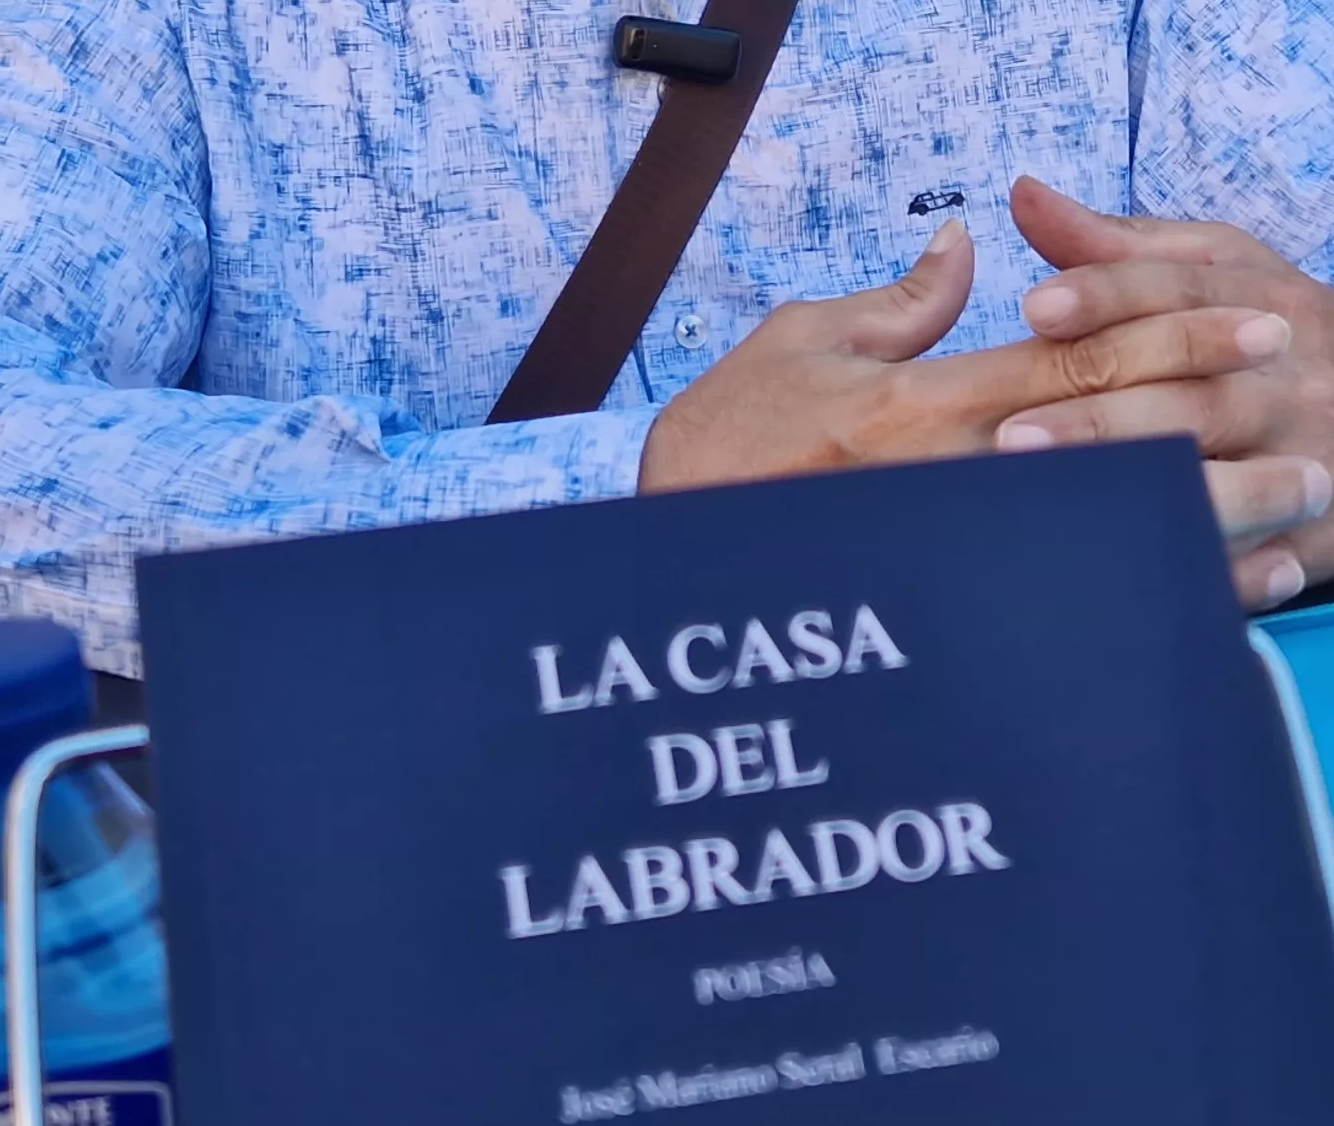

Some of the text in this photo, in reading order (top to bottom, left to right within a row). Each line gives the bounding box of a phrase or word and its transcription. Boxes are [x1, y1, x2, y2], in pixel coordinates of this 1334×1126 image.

[529, 603, 911, 715] LA CASA
[645, 718, 830, 806] DEL
[496, 801, 1013, 940] LABRADOR
[692, 945, 838, 1006] POESÍA
[557, 1076, 636, 1125] José
[635, 1062, 779, 1113] Mariano
[874, 1025, 1000, 1076] Escario
